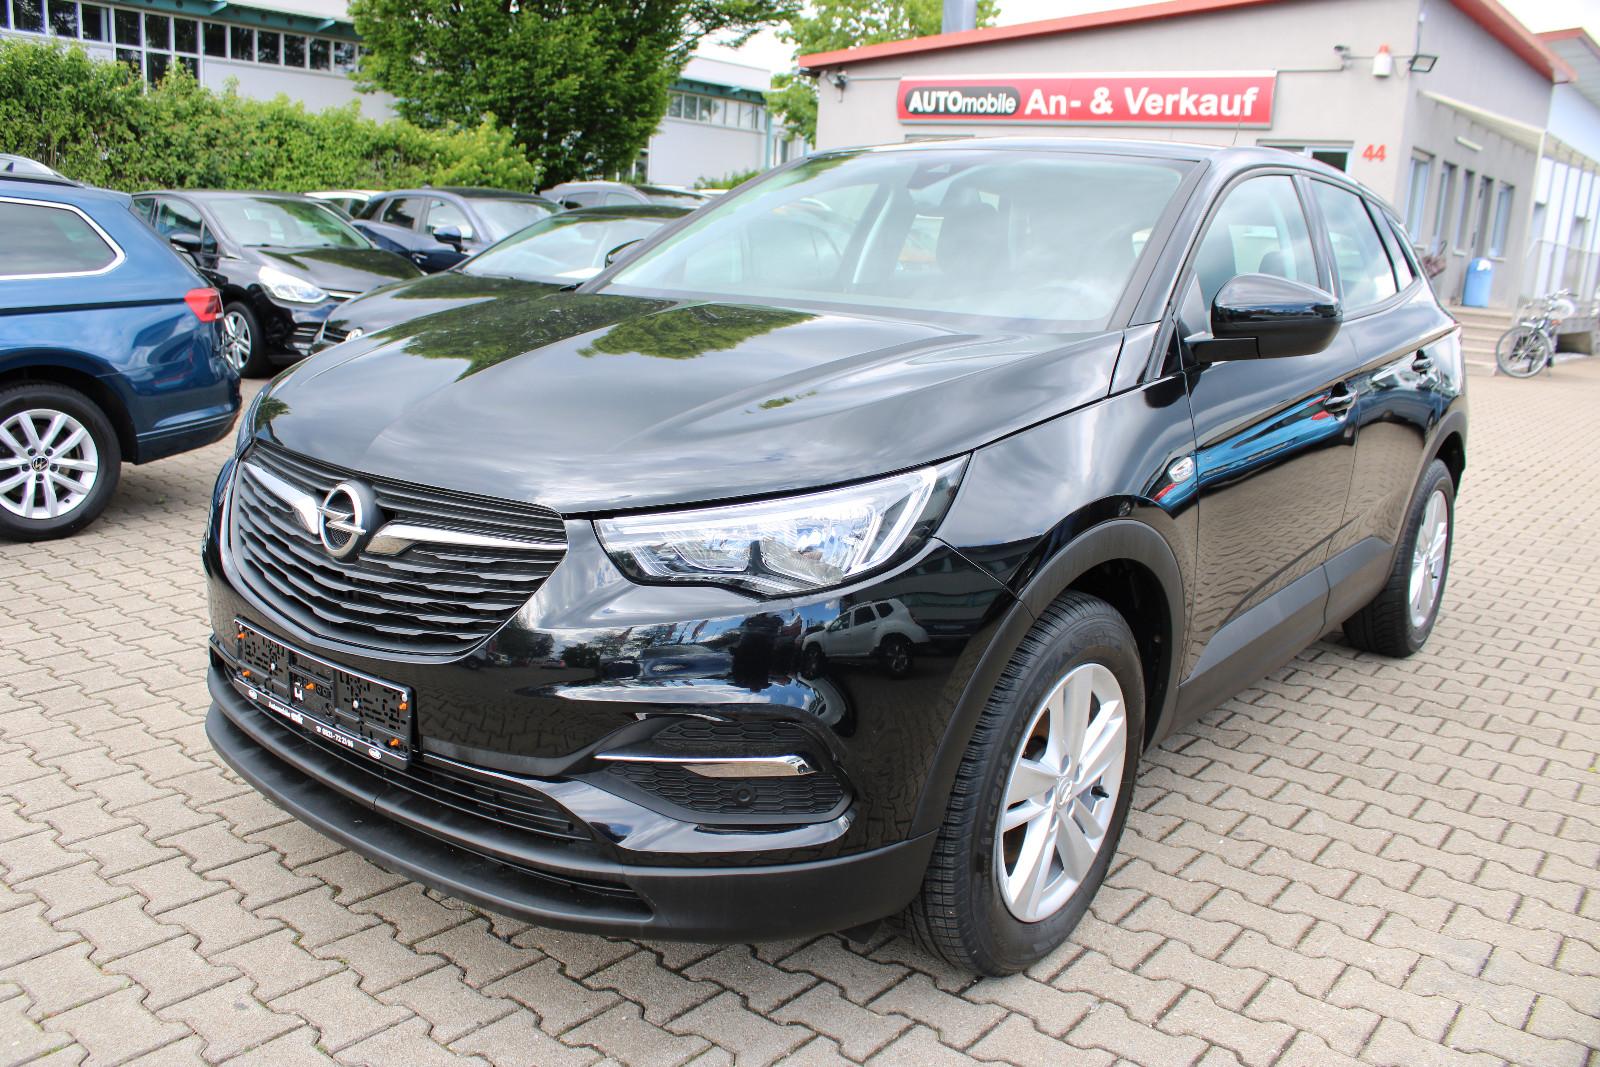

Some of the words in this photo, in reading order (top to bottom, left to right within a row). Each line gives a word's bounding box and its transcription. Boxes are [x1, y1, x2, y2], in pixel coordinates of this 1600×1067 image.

[908, 90, 1016, 114] AUTOmobile
[1024, 88, 1082, 115] An-
[1089, 86, 1113, 115] &
[1124, 86, 1259, 116] Verkauf
[1362, 144, 1386, 161] 44
